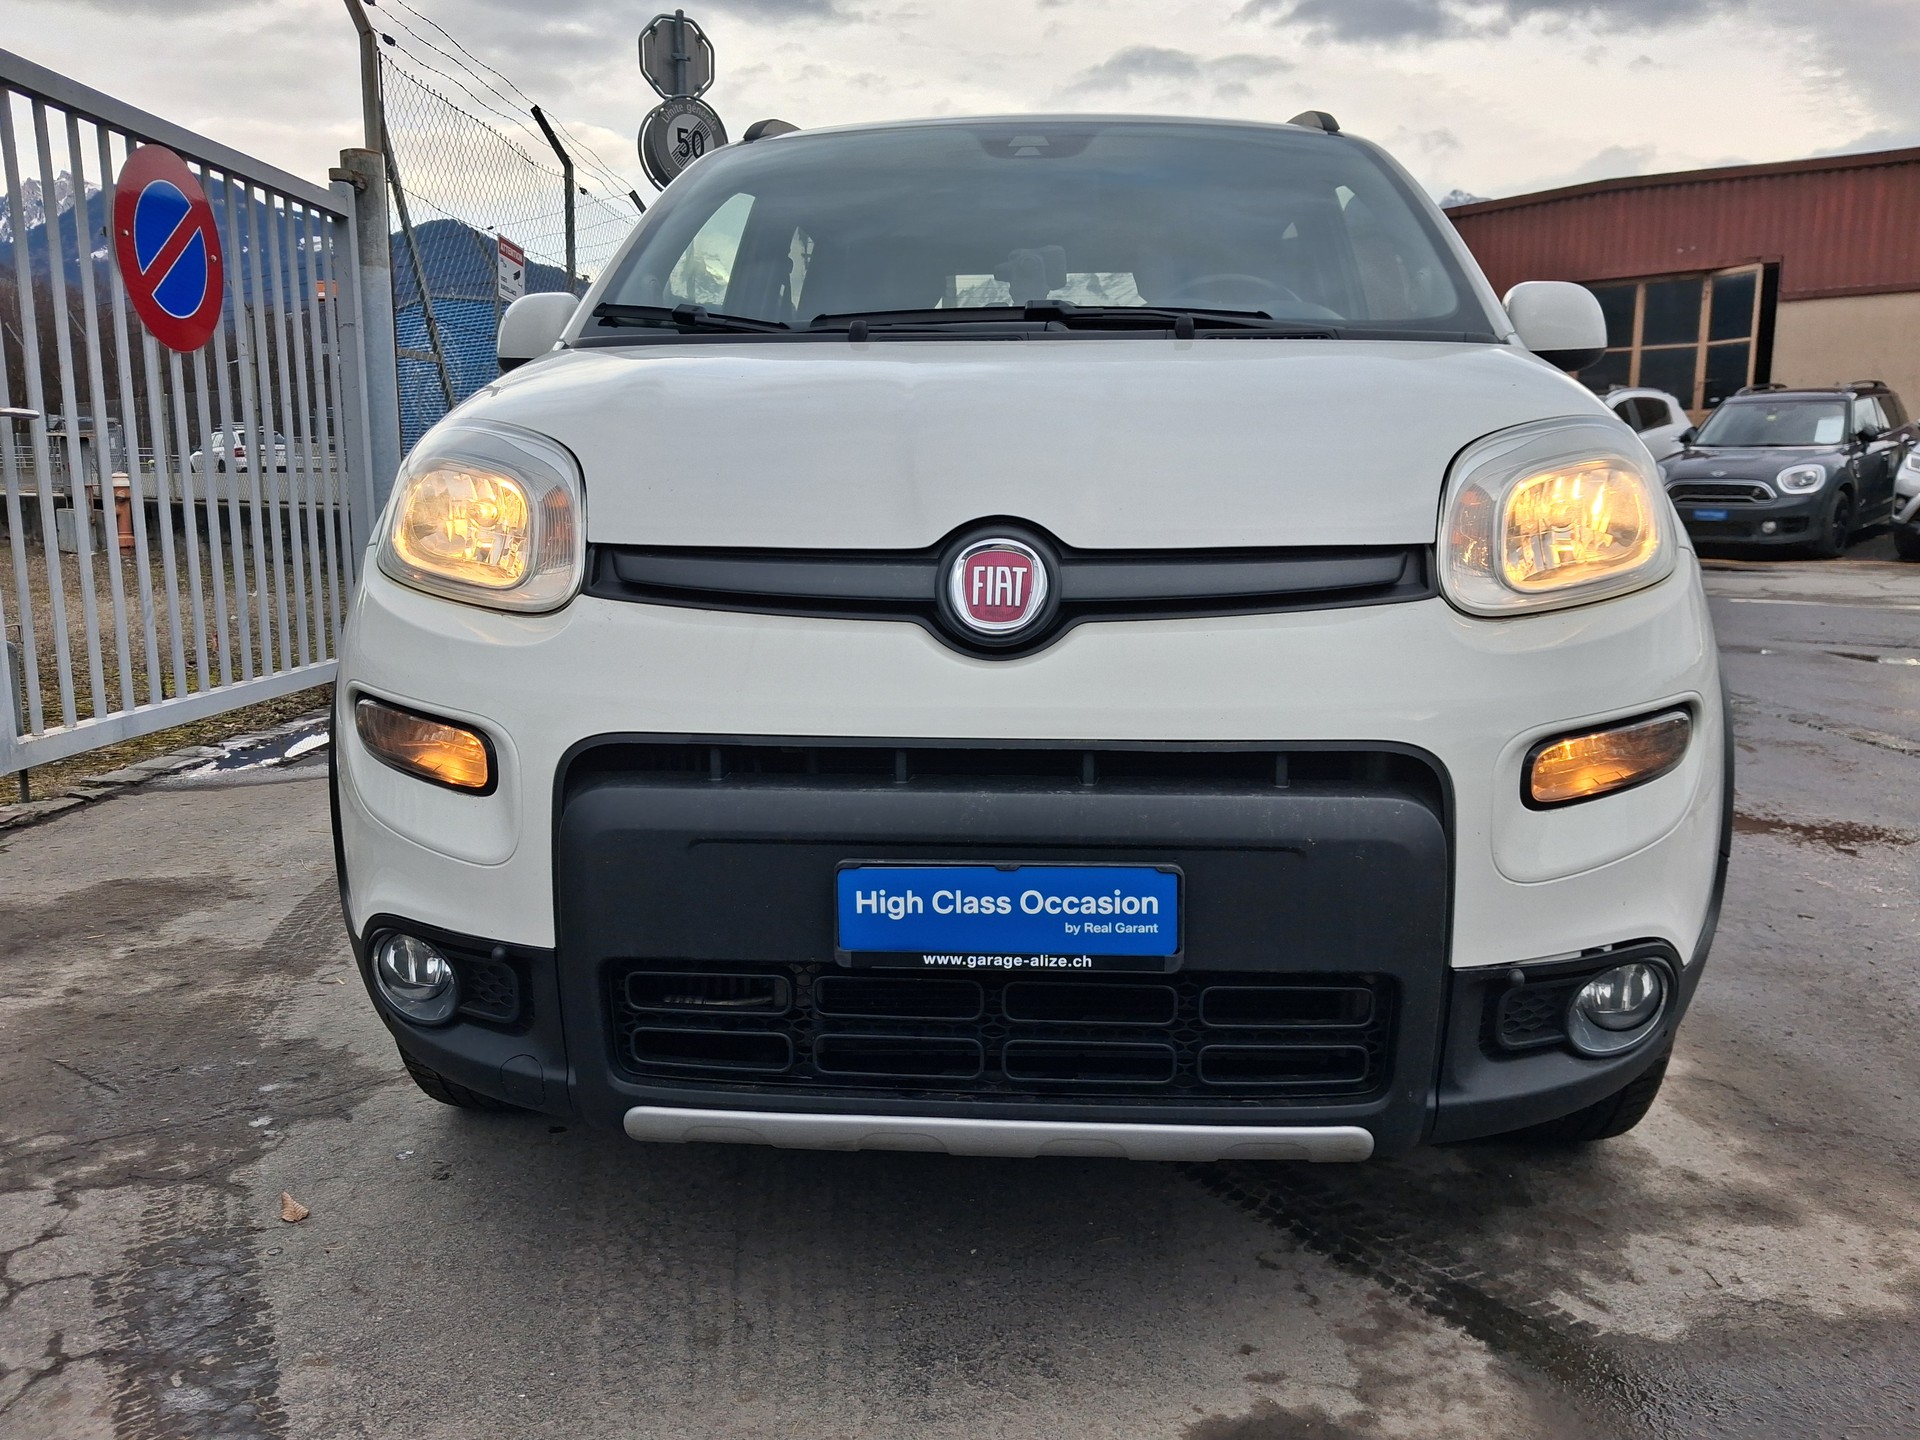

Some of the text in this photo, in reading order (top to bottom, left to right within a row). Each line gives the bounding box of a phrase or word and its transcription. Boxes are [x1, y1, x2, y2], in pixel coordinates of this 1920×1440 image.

[661, 102, 684, 124] Limite
[677, 127, 704, 159] 50
[972, 566, 1028, 607] FIAT
[855, 889, 1159, 920] High Class Occasion
[1064, 922, 1159, 935] by Real Garant
[923, 953, 1092, 968] www.garage-alize.ch
